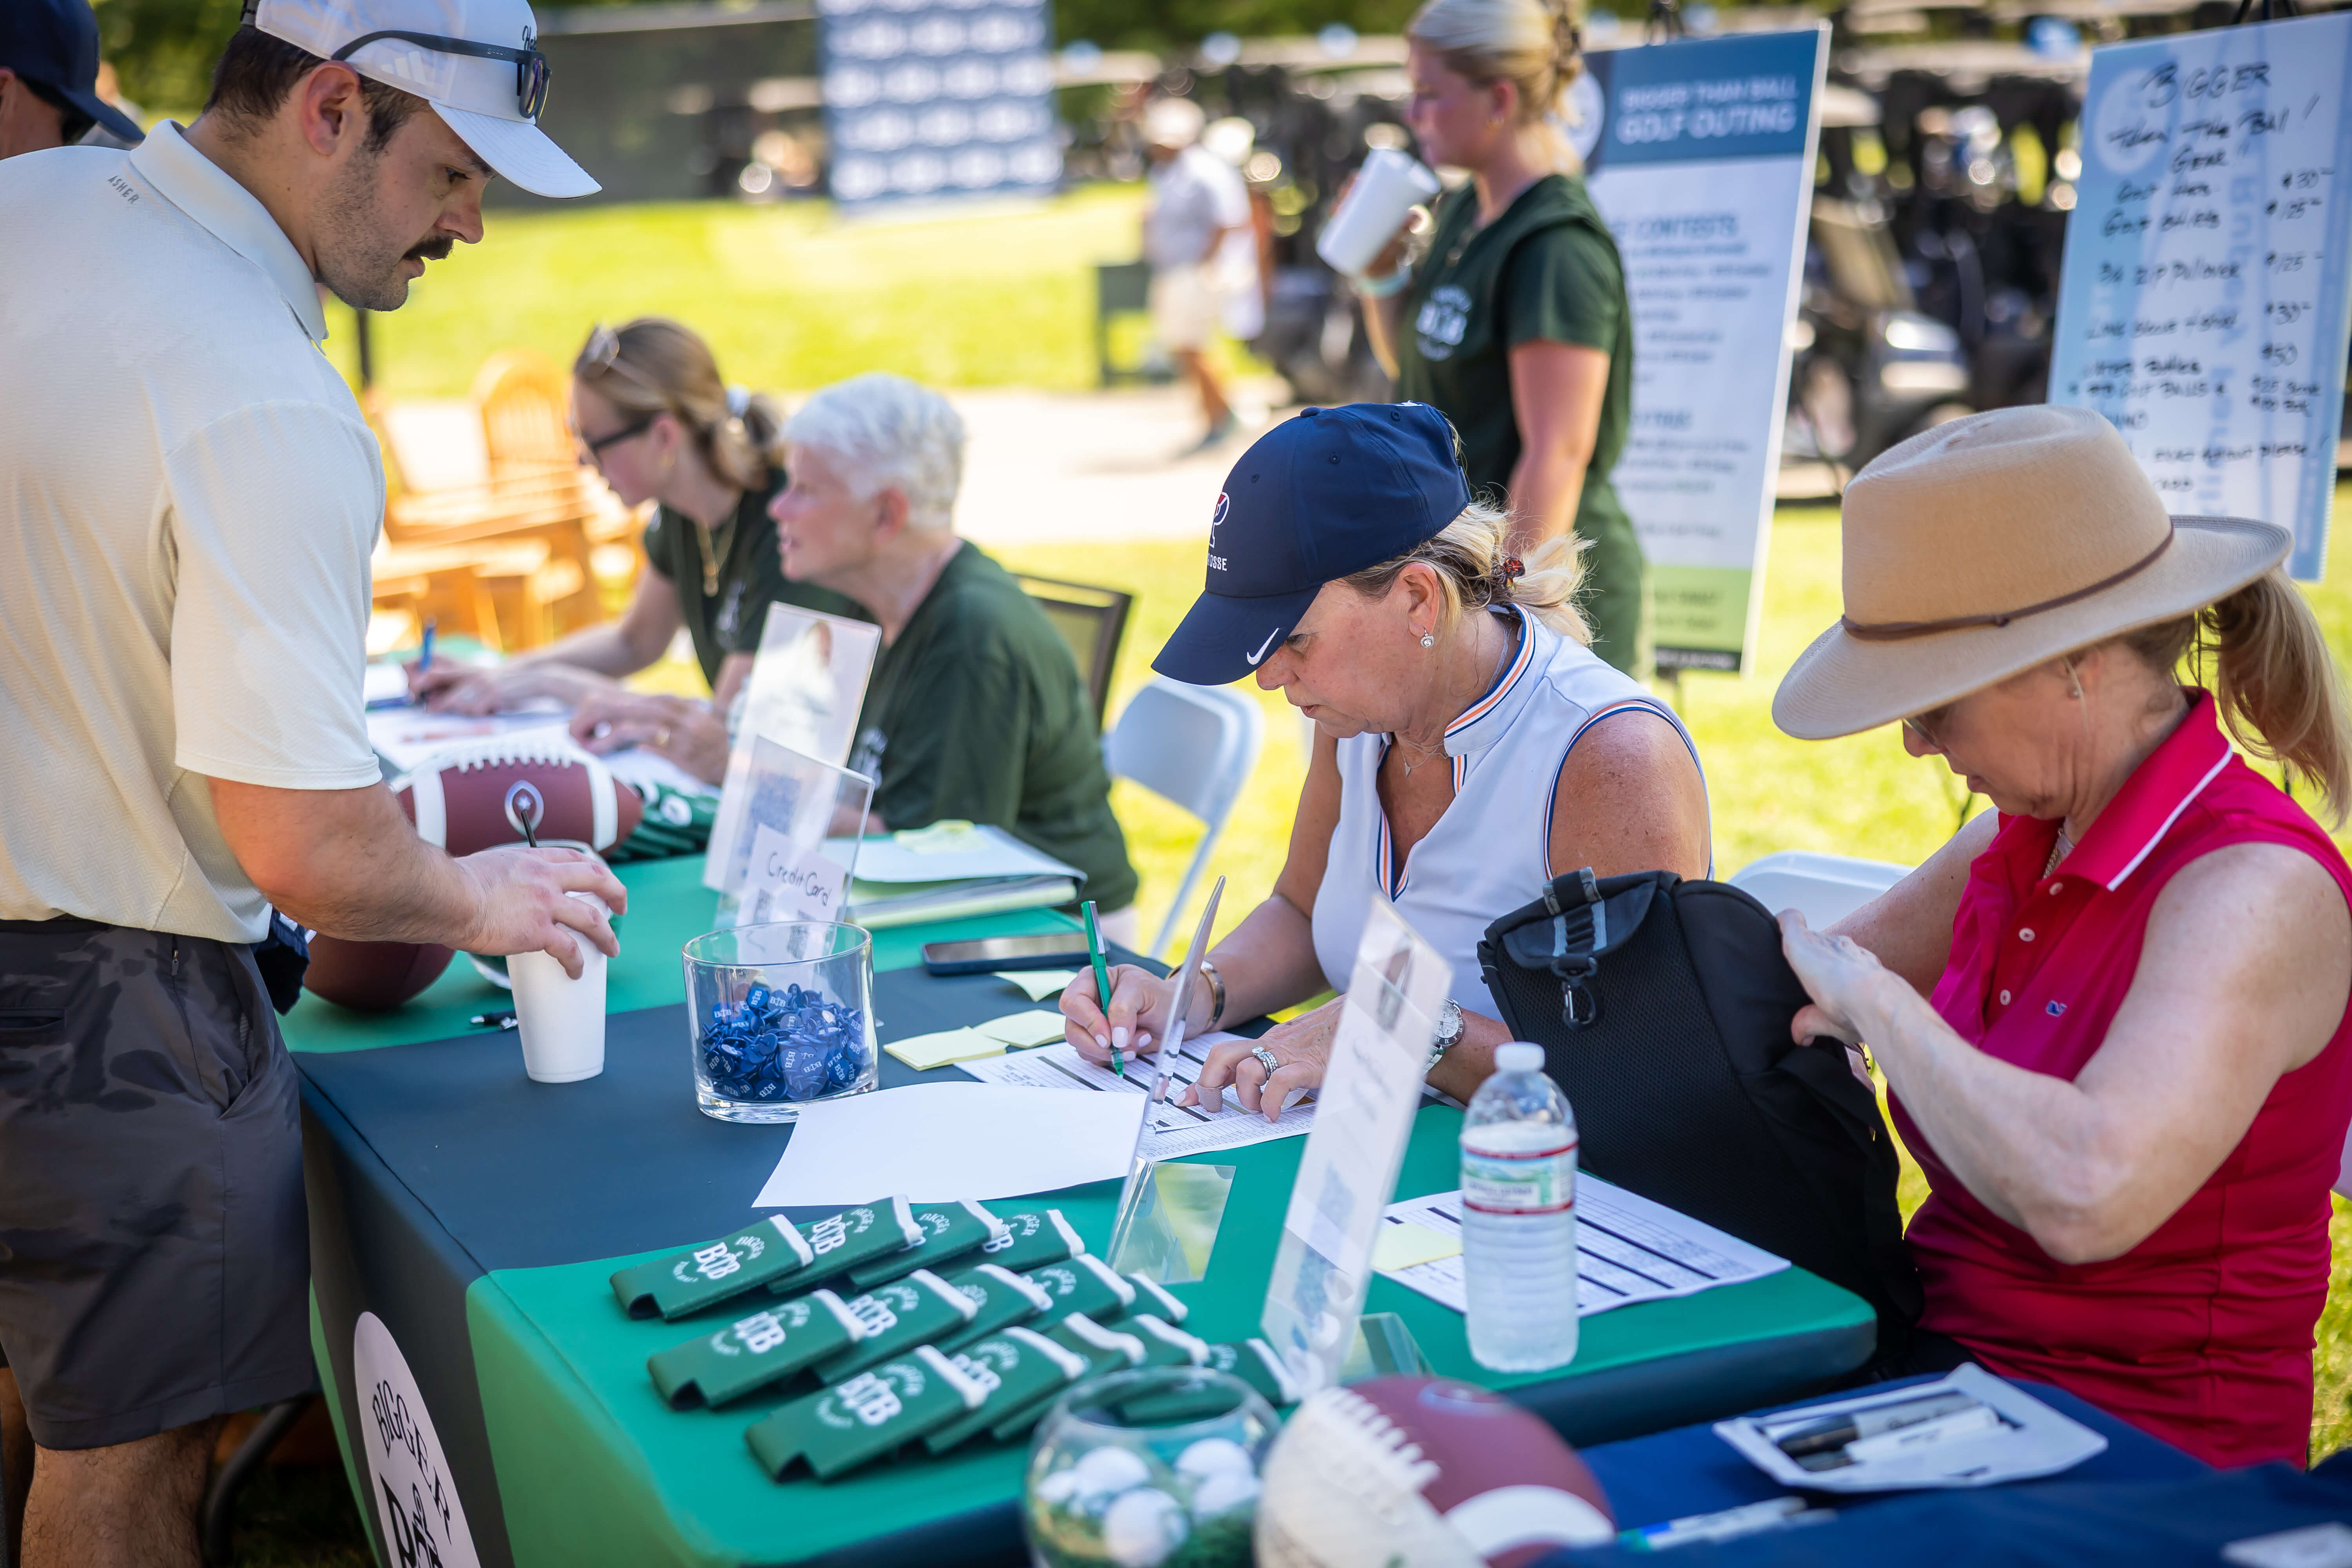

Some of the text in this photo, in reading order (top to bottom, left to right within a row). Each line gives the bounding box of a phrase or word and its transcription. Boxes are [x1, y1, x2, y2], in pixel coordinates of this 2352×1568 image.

[1615, 101, 1798, 145] GOLF OUTING
[107, 175, 139, 204] ASHER
[806, 871, 832, 906] Card
